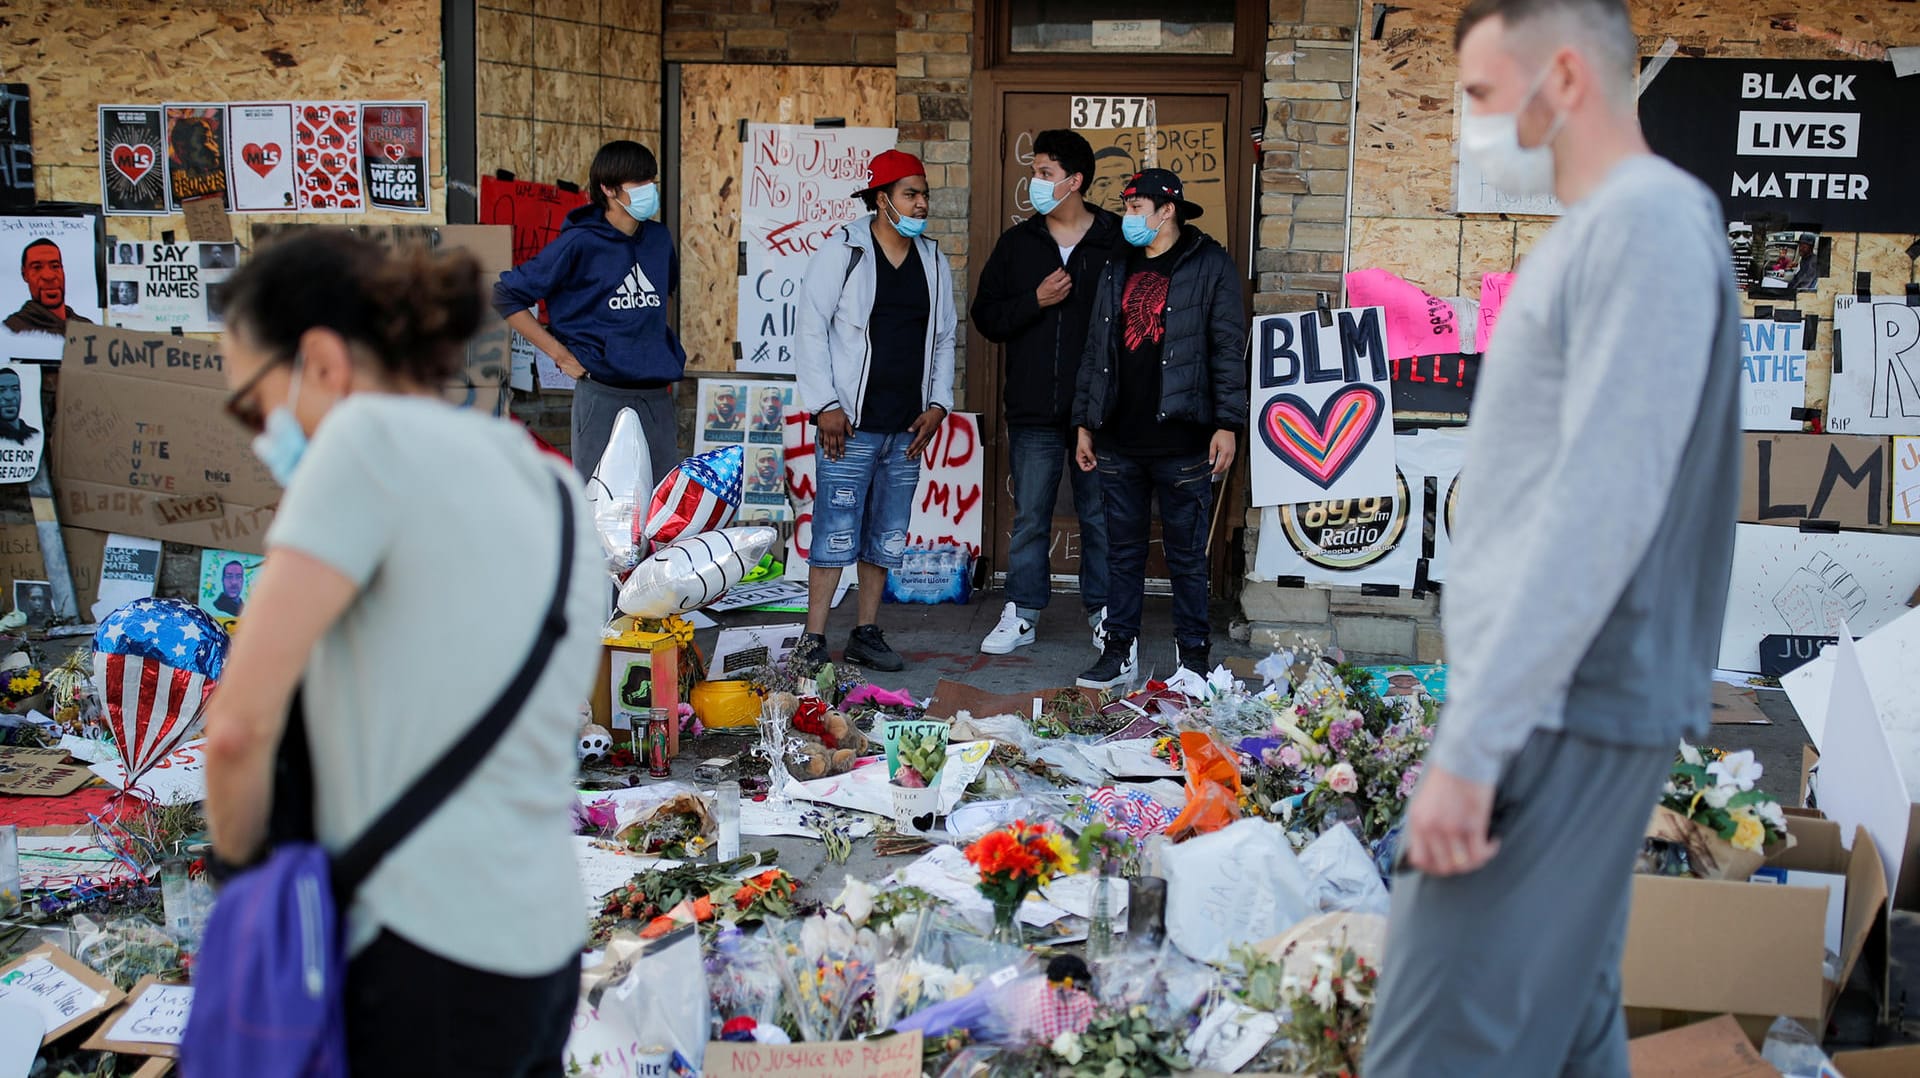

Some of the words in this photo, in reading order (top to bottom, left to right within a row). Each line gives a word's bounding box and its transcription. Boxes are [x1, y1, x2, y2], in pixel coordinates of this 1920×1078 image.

[1741, 72, 1857, 100] BLACK
[1073, 97, 1145, 129] 3757
[1114, 128, 1216, 152] GEORGE
[1752, 122, 1846, 150] LIVES
[754, 129, 795, 166] No
[371, 169, 395, 182] WE
[397, 170, 417, 183] GO
[1730, 170, 1870, 200] MATTER
[372, 182, 418, 201] HIGH
[750, 164, 792, 208] No
[797, 181, 857, 222] Peace
[153, 244, 189, 262] SAY
[146, 264, 199, 281] THEIR
[146, 282, 200, 299] NAMES
[608, 291, 661, 310] adidas
[1837, 297, 1854, 309] RIP
[108, 338, 163, 368] CANT
[1259, 307, 1388, 388] BLM
[135, 421, 166, 436] THE
[1831, 418, 1851, 431] RIP
[16, 450, 34, 462] FOR
[131, 458, 142, 470] U
[9, 466, 36, 478] FLOYD
[129, 472, 176, 490] GIVE
[1758, 440, 1883, 526] LM
[1304, 497, 1381, 528] 89.9
[1320, 526, 1379, 547] Radio
[105, 547, 140, 556] BLACK
[105, 555, 131, 563] LIVES
[104, 562, 140, 572] MATTER
[901, 577, 927, 585] Purified
[927, 576, 950, 585] Water
[731, 1050, 761, 1072] NO
